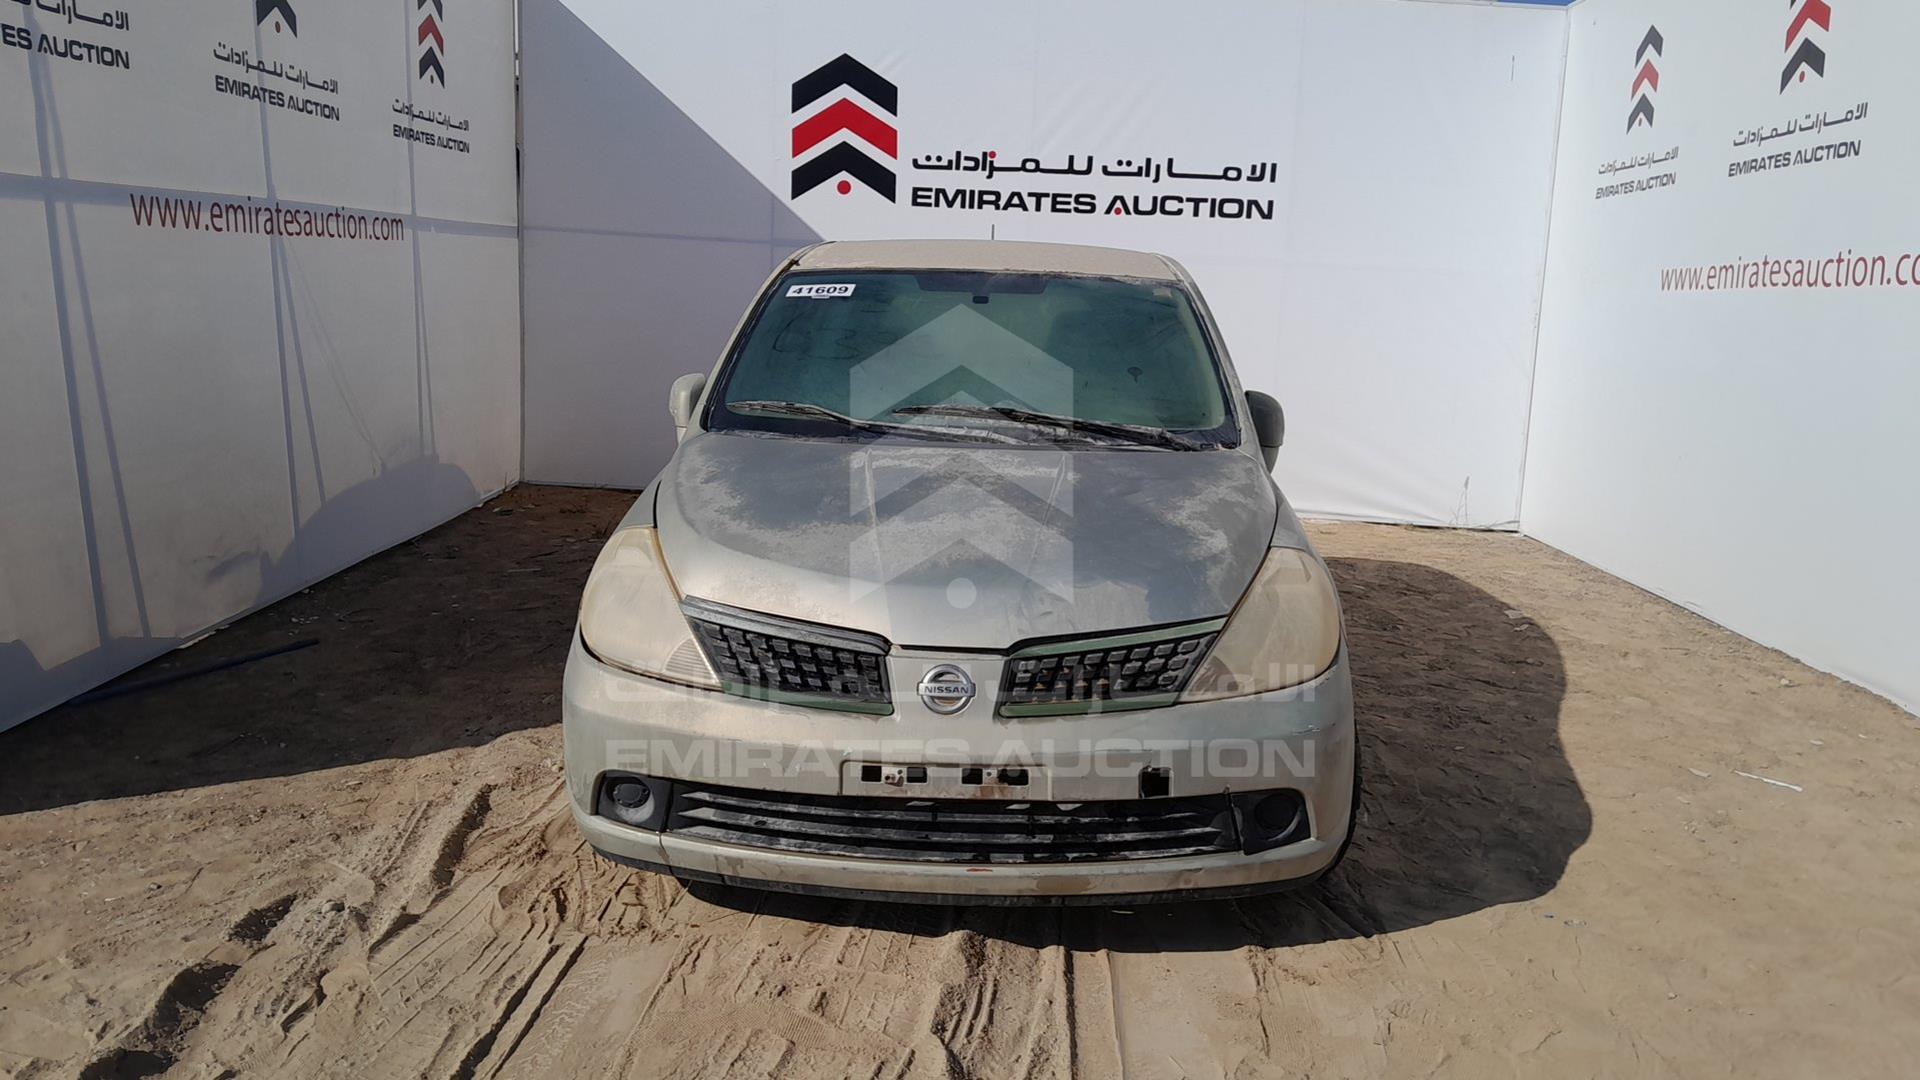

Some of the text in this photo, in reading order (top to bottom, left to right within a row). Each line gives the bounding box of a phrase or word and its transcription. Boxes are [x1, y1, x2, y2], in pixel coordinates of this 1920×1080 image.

[37, 33, 130, 70] AUCTION
[215, 75, 340, 121] EMIRATES AUCTION
[393, 124, 470, 154] EMIRATES AUCTION
[912, 150, 1277, 183] الامارات للمزادات
[1728, 139, 1861, 177] EMIRATES AUCTION
[1595, 172, 1677, 199] EMIRATES AUCTION
[130, 193, 405, 241] www.emiratesauction.com
[911, 187, 1275, 219] EMIRATES AUCTION
[792, 286, 849, 294] 41609
[924, 685, 969, 694] NISSAN
